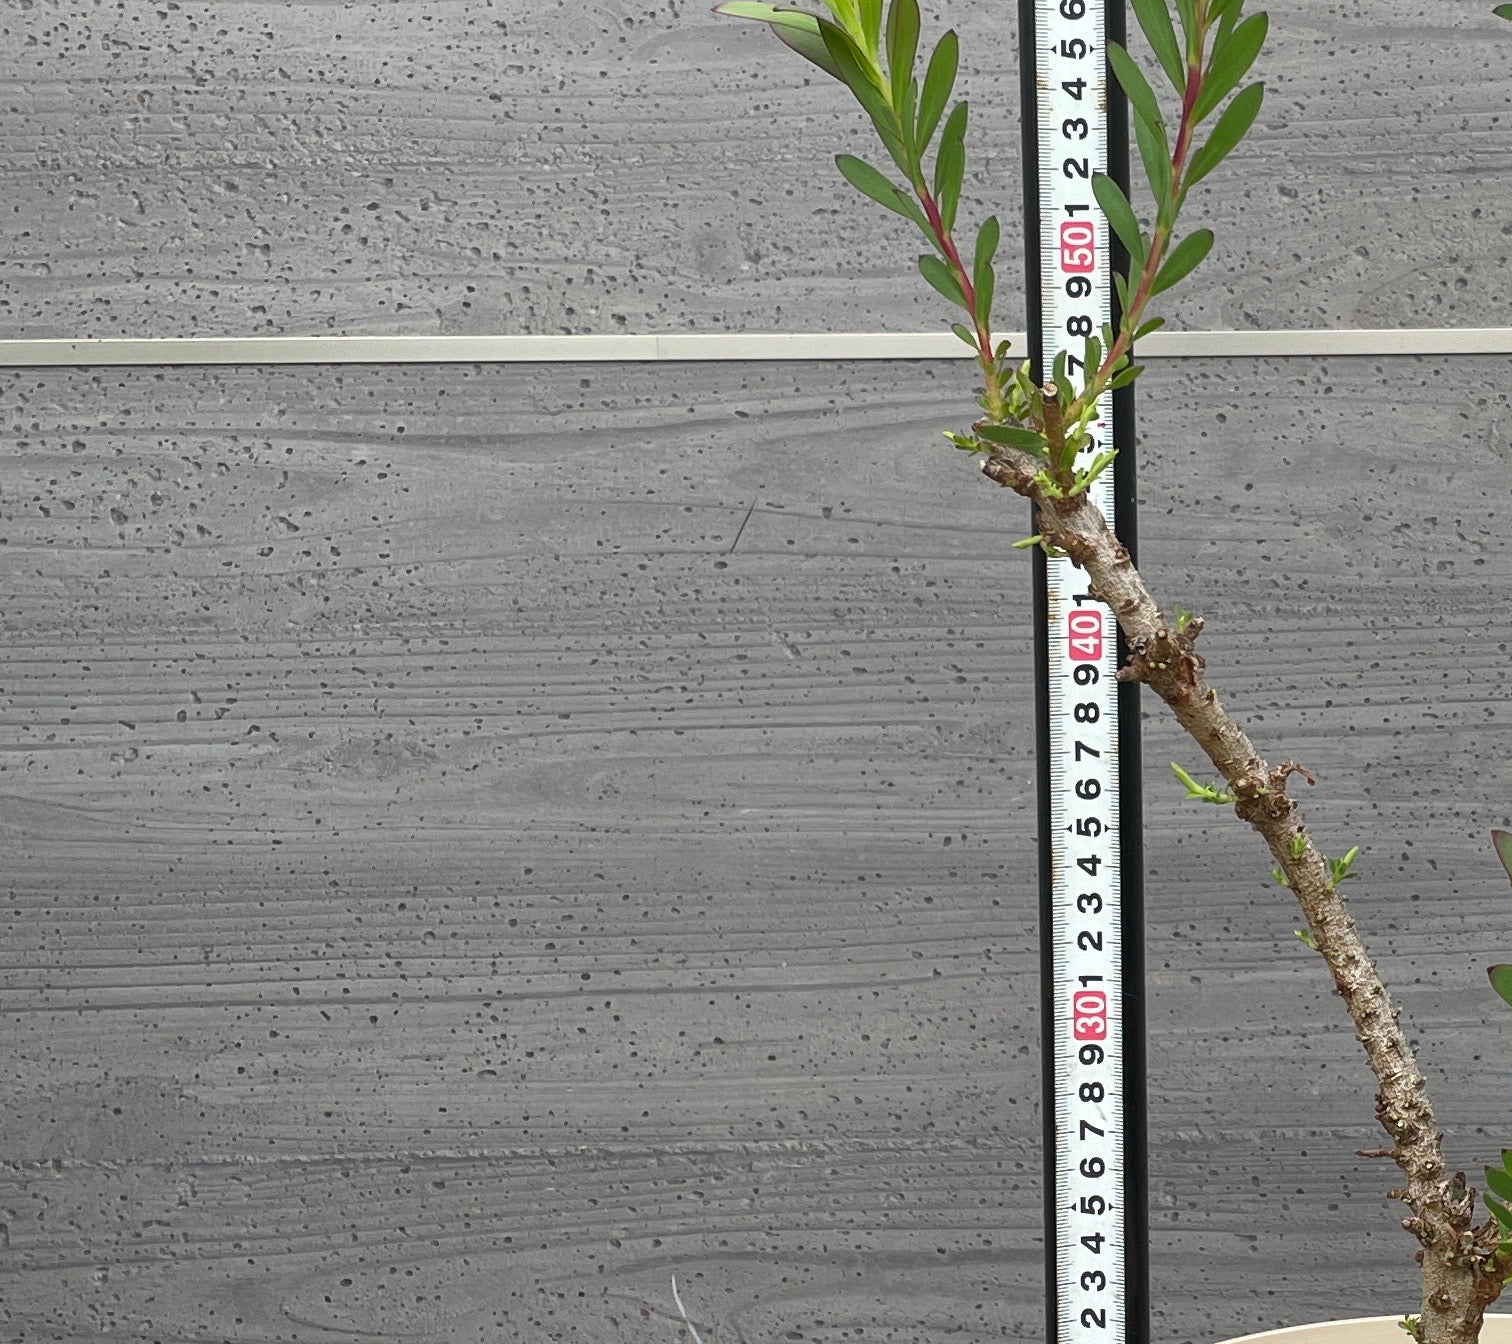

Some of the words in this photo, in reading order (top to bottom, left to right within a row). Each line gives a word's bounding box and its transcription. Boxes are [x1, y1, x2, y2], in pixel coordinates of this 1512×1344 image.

[1061, 39, 1086, 59] 5
[1062, 78, 1086, 100] 4
[1063, 118, 1088, 139] 3
[1063, 158, 1088, 178] 2
[1065, 205, 1089, 217] 1
[1063, 227, 1093, 266] 50
[1066, 276, 1091, 298] 9
[1067, 315, 1092, 336] 8
[1071, 616, 1099, 654] 40
[1074, 664, 1099, 685] 9
[1074, 702, 1099, 723] 8
[1075, 741, 1099, 761] 7
[1075, 779, 1101, 799] 6
[1077, 817, 1101, 837] 5
[1077, 855, 1101, 876] 4
[1077, 893, 1102, 913] 3
[1078, 931, 1102, 951] 2
[1079, 976, 1102, 987] 1
[1076, 996, 1104, 1033] 30
[1079, 1044, 1104, 1065] 9
[1079, 1082, 1104, 1103] 8
[1080, 1120, 1104, 1140] 7
[1080, 1157, 1105, 1178] 6
[1081, 1195, 1105, 1215] 5
[1081, 1233, 1105, 1254] 4
[1081, 1271, 1105, 1291] 3
[1081, 1309, 1105, 1328] 2
